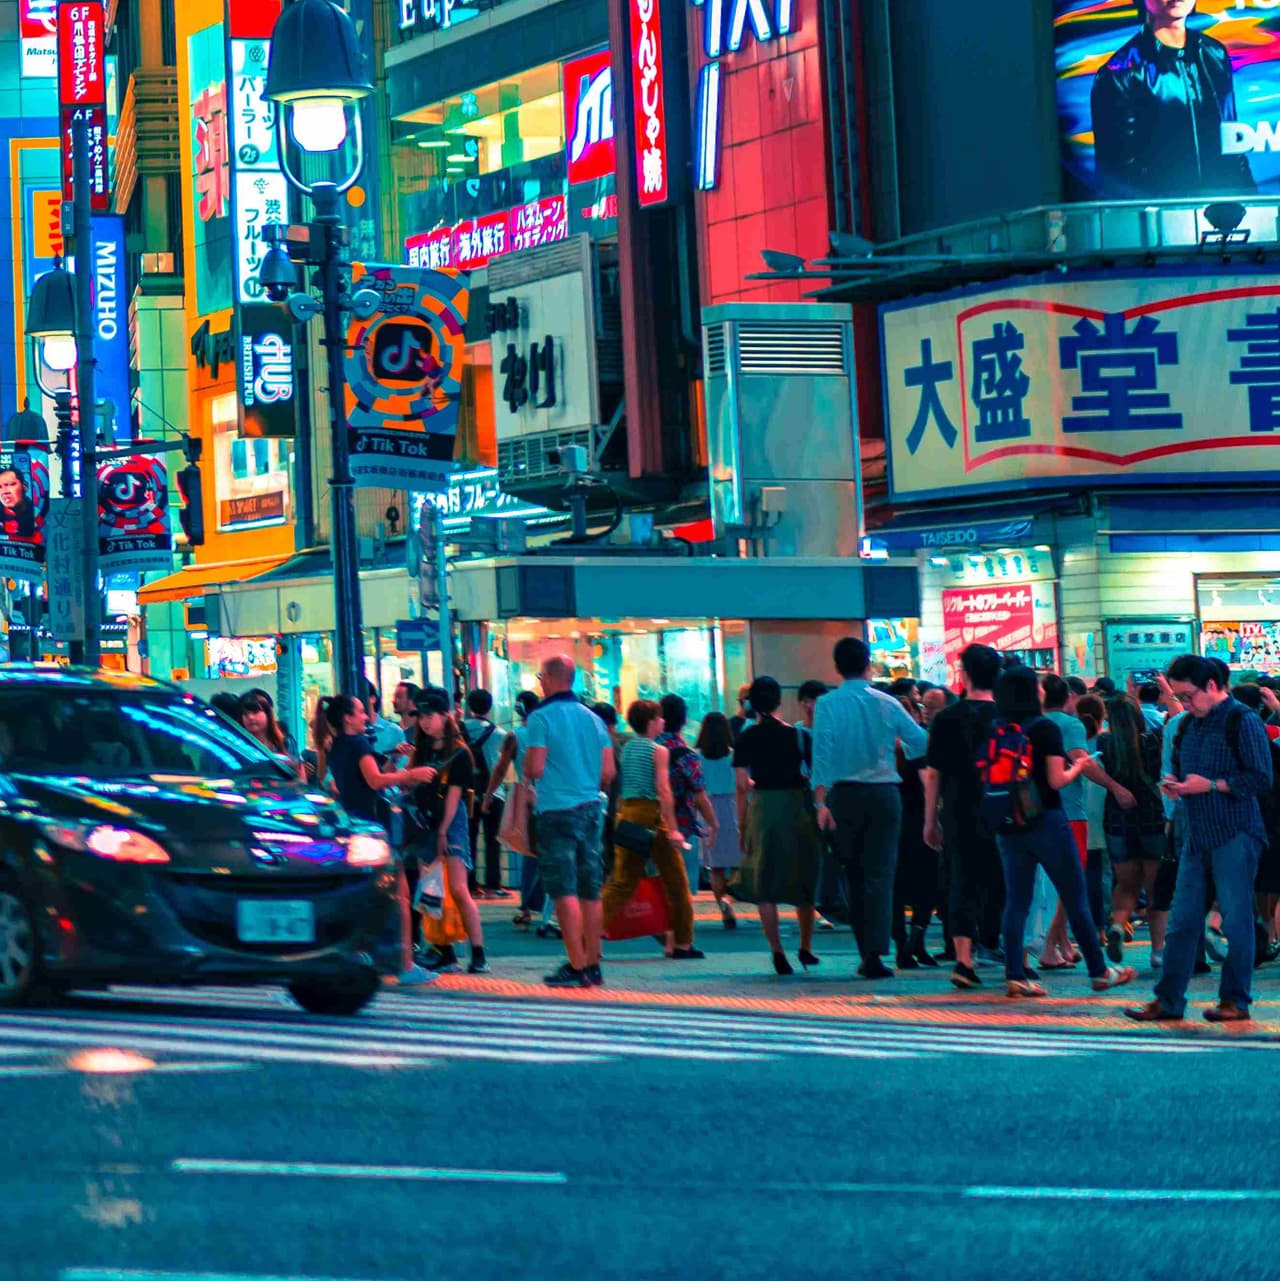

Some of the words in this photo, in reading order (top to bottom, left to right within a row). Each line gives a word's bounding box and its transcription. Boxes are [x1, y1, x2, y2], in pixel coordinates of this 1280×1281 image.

[70, 7, 89, 21] 6F
[242, 148, 258, 162] 2F
[458, 222, 505, 262] 海外旅行
[95, 240, 118, 340] MIZUHO
[242, 335, 254, 384] BRITISH
[254, 332, 293, 405] HUB
[243, 385, 255, 407] PUB
[371, 437, 395, 453] Tik
[398, 439, 428, 457] Tok
[920, 528, 977, 545] TAISEIDO
